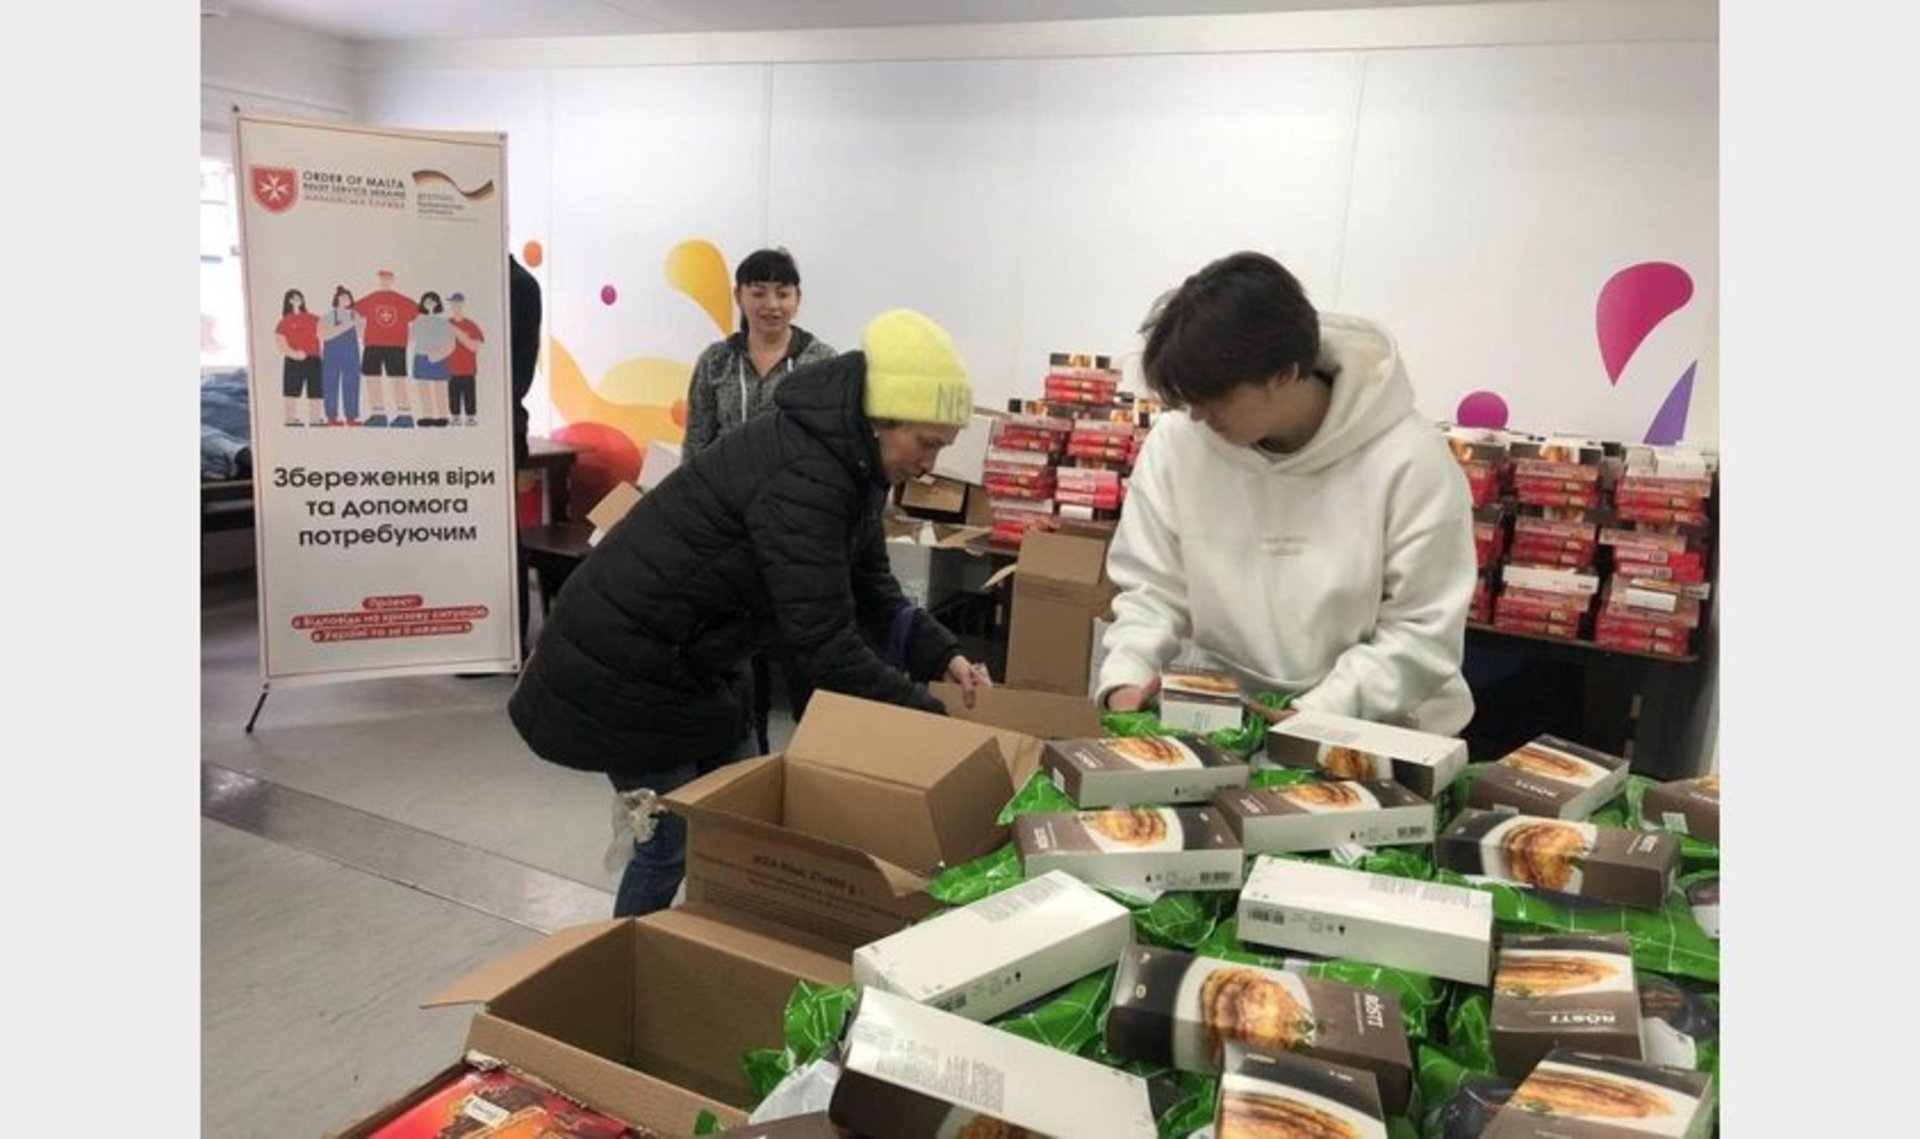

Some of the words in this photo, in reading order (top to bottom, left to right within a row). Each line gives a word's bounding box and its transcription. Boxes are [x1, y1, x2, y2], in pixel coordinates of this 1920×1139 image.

[302, 169, 342, 184] ORDER
[345, 174, 362, 186] OF
[366, 176, 405, 189] MALTA
[273, 467, 441, 490] Збереження
[446, 467, 496, 488] віри
[306, 500, 336, 516] та
[341, 498, 469, 519] допомога
[298, 523, 478, 549] потребуючим
[1364, 993, 1385, 1029] RÖSTI
